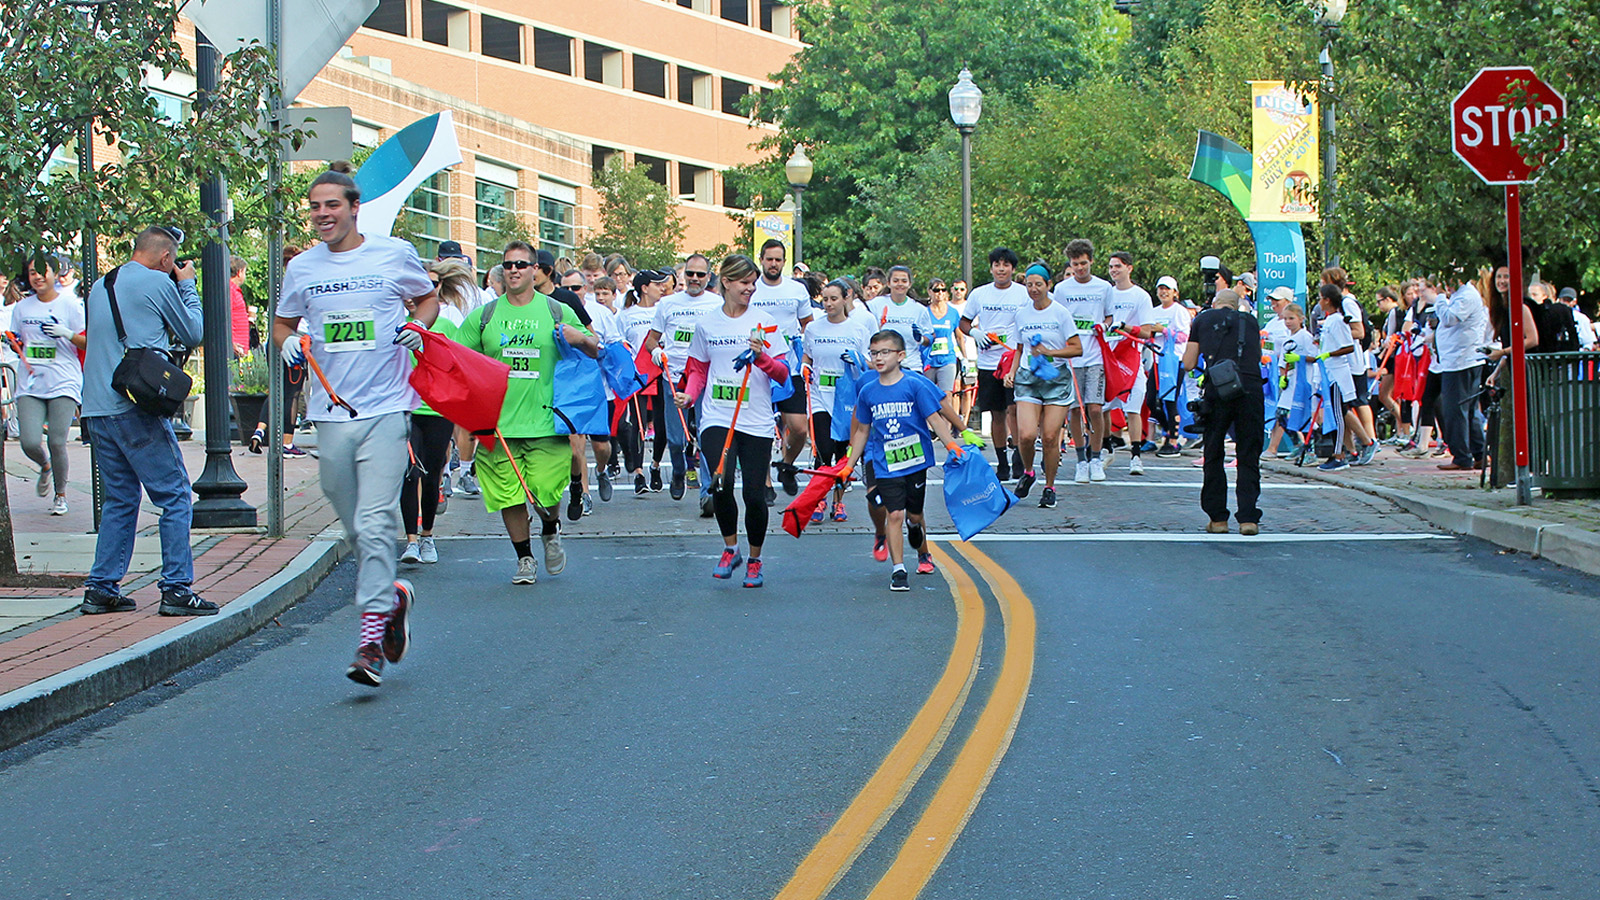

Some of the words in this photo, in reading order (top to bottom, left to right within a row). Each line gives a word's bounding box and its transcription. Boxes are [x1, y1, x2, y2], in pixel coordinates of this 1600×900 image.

[1260, 95, 1307, 114] NICE
[1255, 117, 1309, 169] FESTIVAL
[1260, 159, 1281, 181] OYSTER
[1280, 143, 1297, 160] SHELL
[1296, 128, 1312, 145] PARK
[1263, 167, 1284, 189] JULY
[1293, 135, 1316, 160] 2019
[1264, 252, 1298, 263] Thank
[1264, 268, 1285, 279] You
[308, 280, 383, 296] TRASHDASH
[331, 321, 366, 343] 229
[500, 333, 535, 347] DASH
[33, 346, 53, 358] 165
[512, 357, 529, 371] 53
[892, 445, 918, 463] 131
